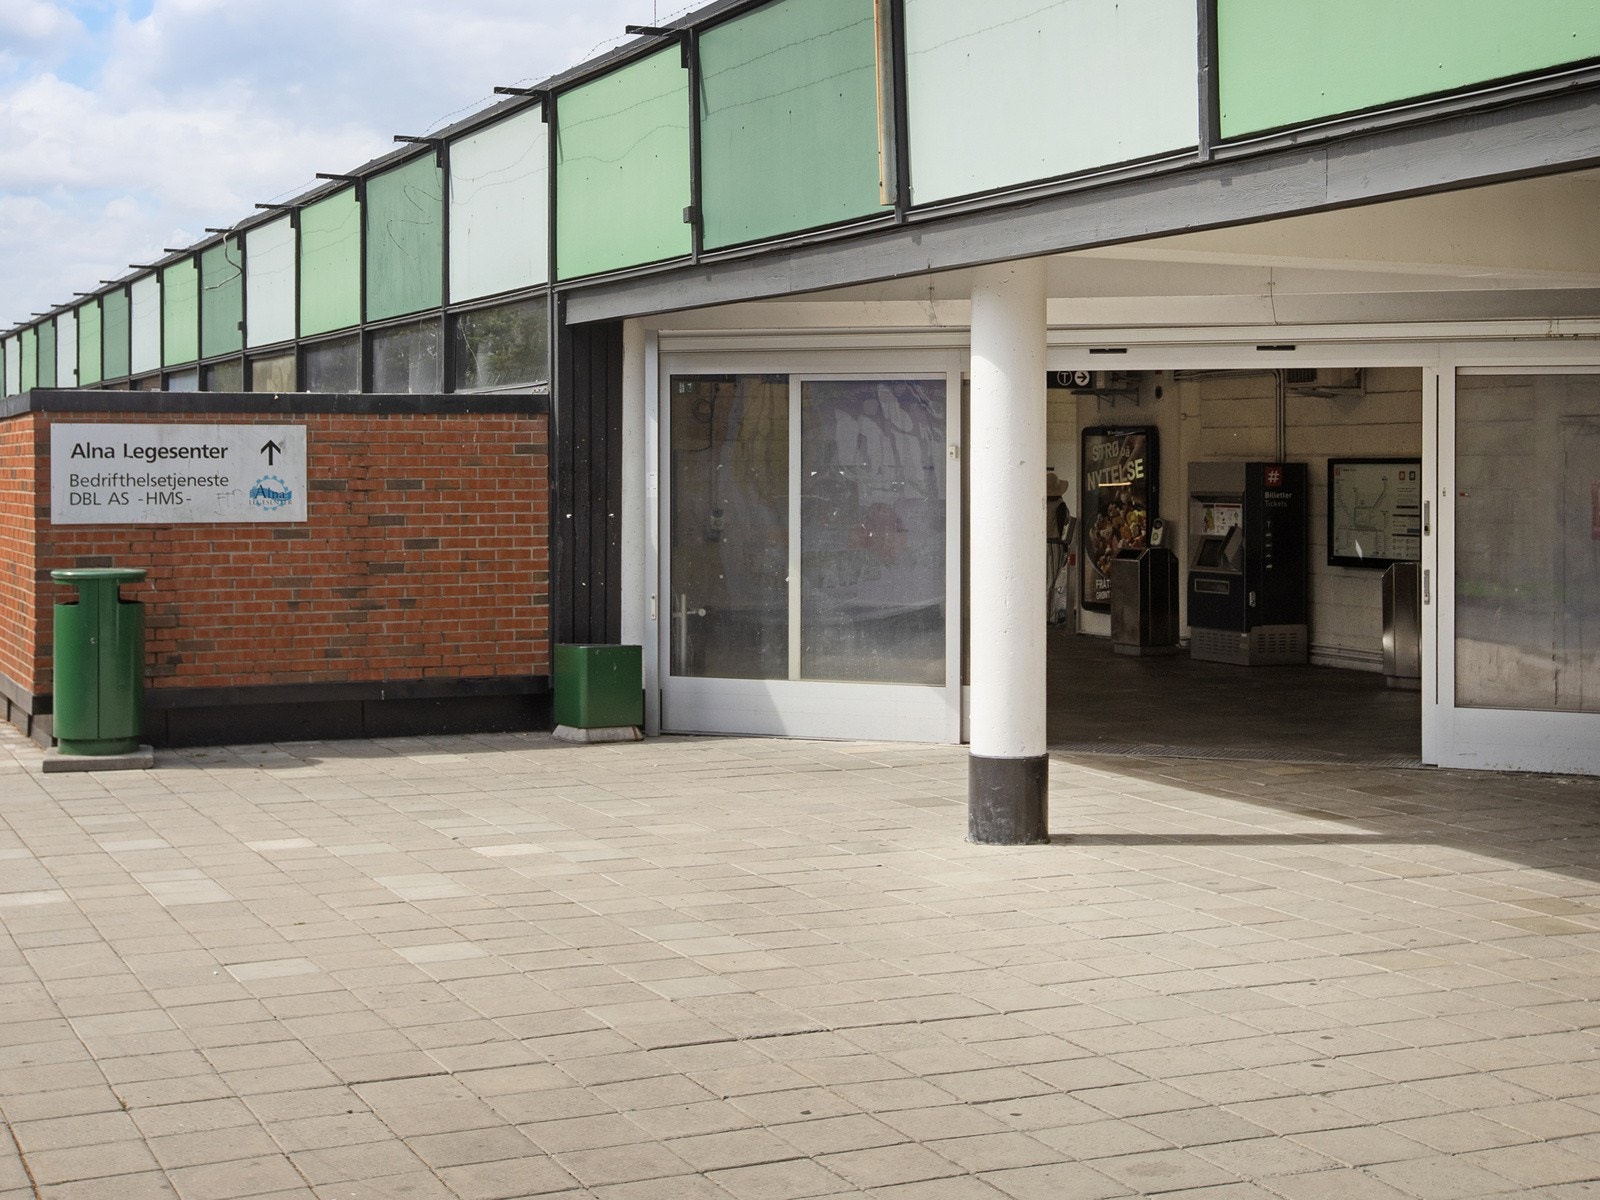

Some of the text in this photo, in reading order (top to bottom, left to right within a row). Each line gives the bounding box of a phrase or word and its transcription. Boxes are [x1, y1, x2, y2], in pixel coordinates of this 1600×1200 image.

[70, 442, 229, 463] Alna Legesenter
[1092, 440, 1119, 462] STRØ
[69, 472, 229, 490] Bedrifthelsetjeneste
[1087, 458, 1144, 491] NYTELSE
[69, 491, 102, 506] DBL
[107, 491, 130, 506] AS
[253, 484, 286, 499] Alna
[1264, 491, 1293, 499] Billetter
